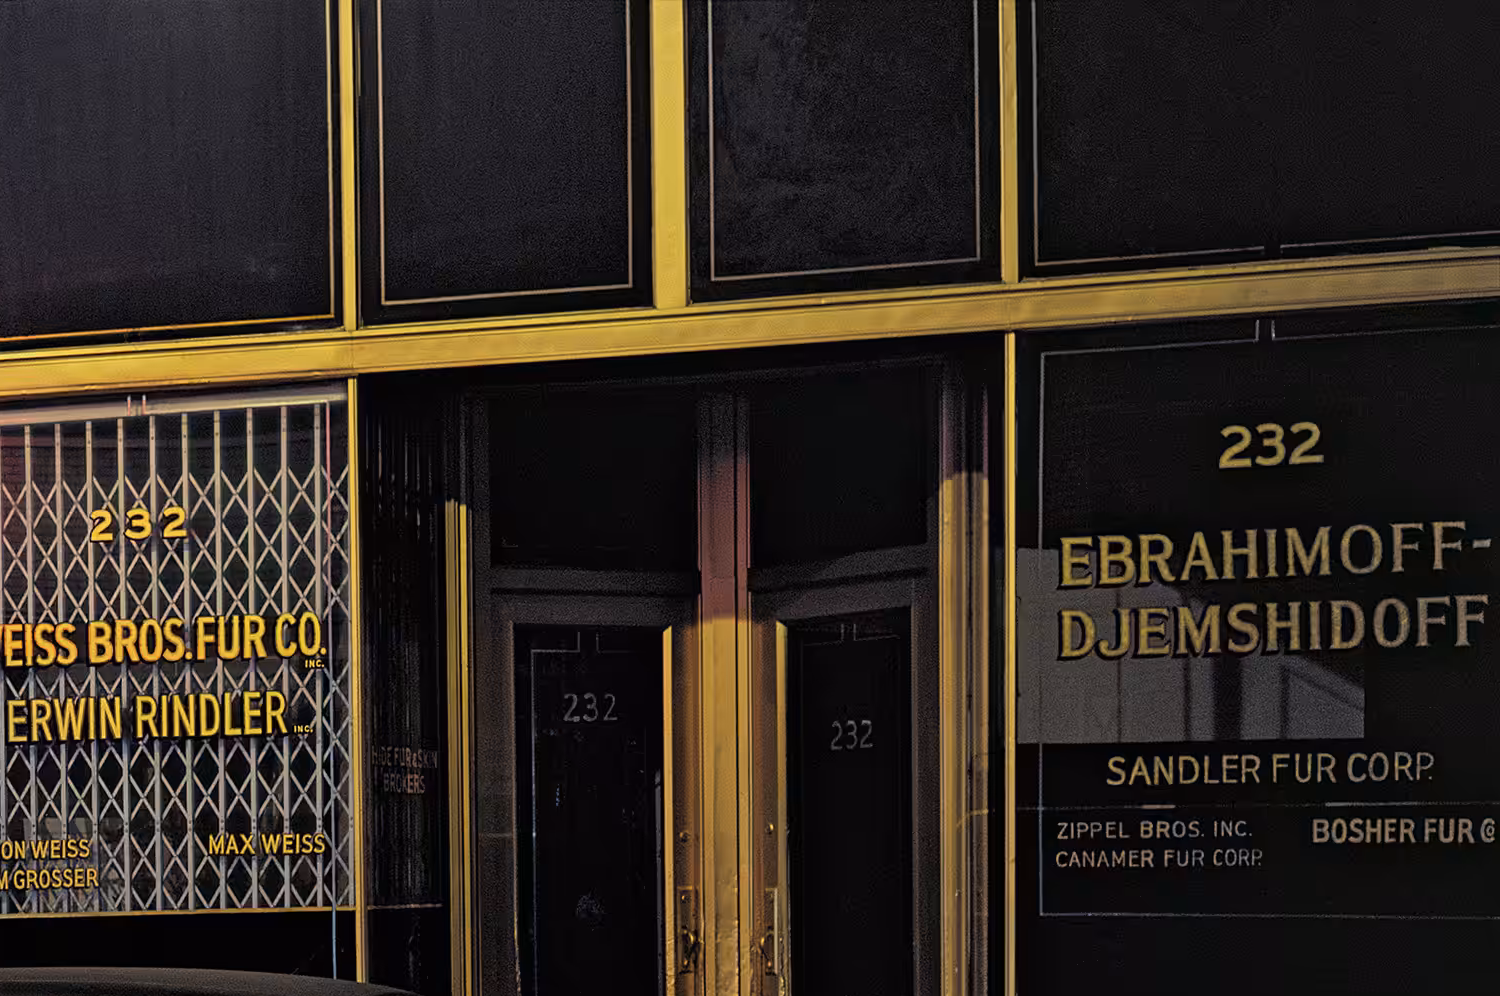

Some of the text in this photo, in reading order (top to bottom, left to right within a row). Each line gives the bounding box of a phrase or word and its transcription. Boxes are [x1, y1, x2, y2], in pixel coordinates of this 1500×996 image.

[1218, 421, 1324, 469] 232
[89, 507, 188, 541] 232
[1057, 520, 1492, 588] EBRAHIMOFF-
[275, 611, 326, 658] CO.
[1057, 594, 1490, 660] DJEMSHIDOFF
[304, 659, 325, 668] INC.
[6, 691, 313, 744] ERWIN RINDLER INC.
[563, 692, 618, 723] 232
[830, 719, 874, 751] 232
[1106, 752, 1435, 786] SANDLER FUR CORP.
[208, 833, 325, 855] MAX WEISS
[1056, 819, 1253, 840] ZIPPEL BROS. INC.
[1312, 818, 1417, 844] BOSHER
[1424, 818, 1475, 844] FUR
[31, 838, 90, 859] WEISS
[1055, 848, 1263, 868] CANAMER FUR CORP.
[13, 867, 99, 890] GROSSER
